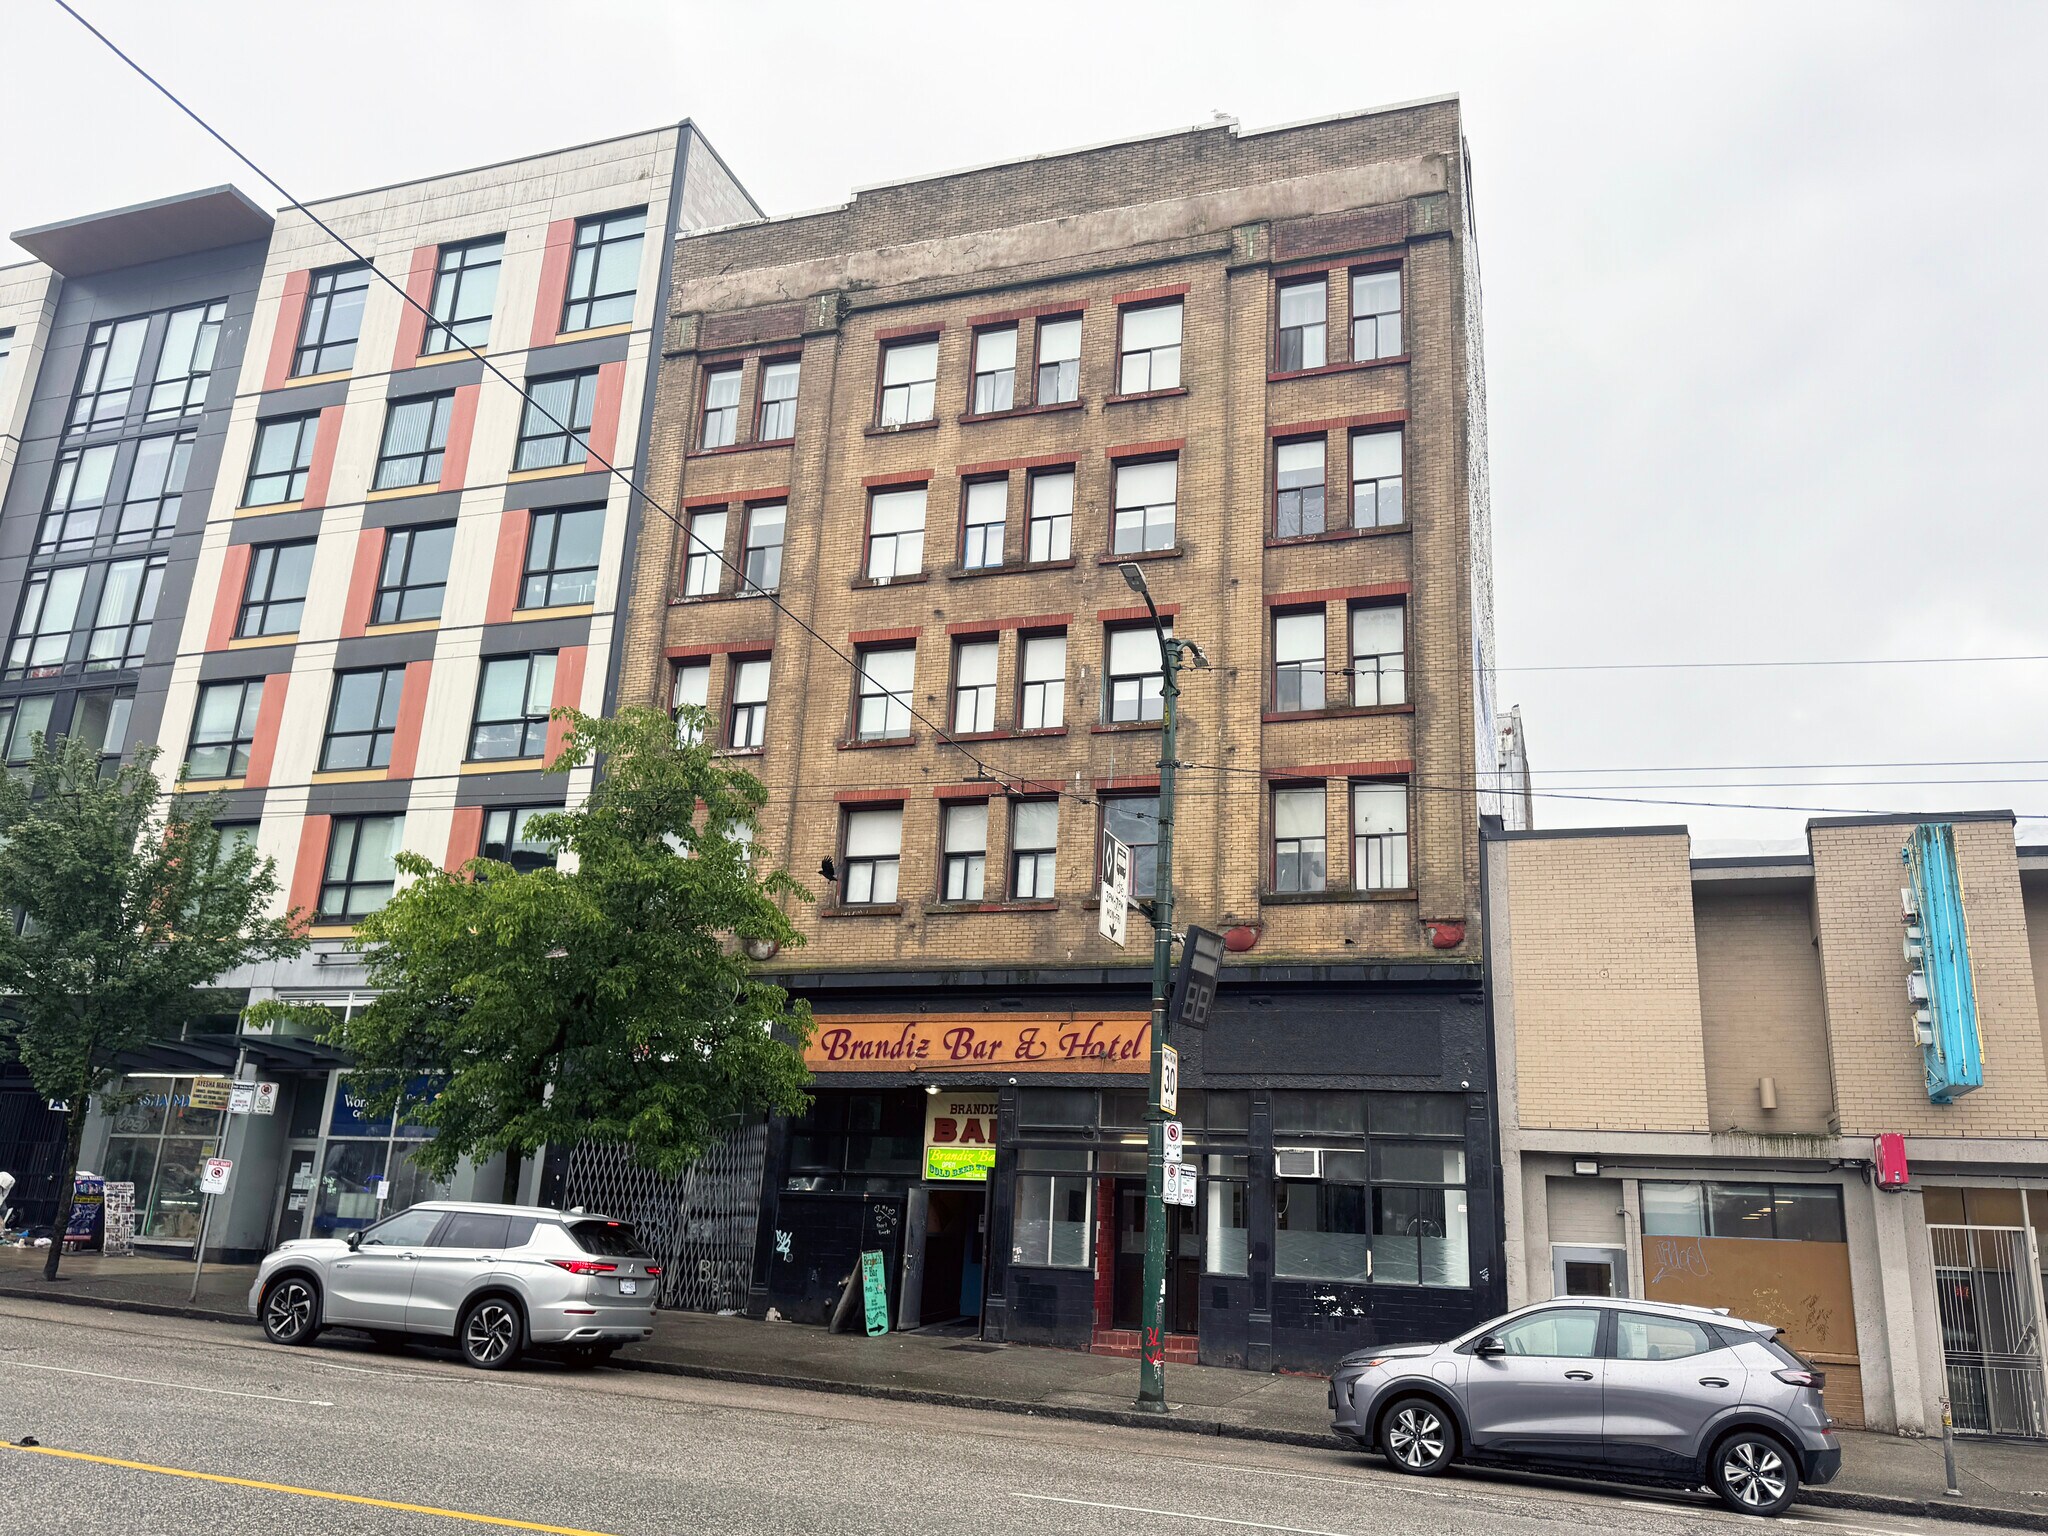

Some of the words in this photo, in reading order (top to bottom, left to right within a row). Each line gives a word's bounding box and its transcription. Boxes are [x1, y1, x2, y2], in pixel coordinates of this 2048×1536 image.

[821, 1021, 931, 1061] Brandiz
[943, 1027, 1003, 1061] Bar
[1014, 1027, 1047, 1060] &
[1058, 1020, 1151, 1061] Hotel
[196, 1079, 216, 1089] AYESHA
[1164, 1064, 1176, 1096] 30
[950, 1103, 999, 1115] BRANDIZ
[929, 1150, 977, 1165] Brandiz
[942, 1161, 956, 1169] OPEN
[929, 1163, 951, 1178] COLD
[952, 1164, 975, 1178] BEER
